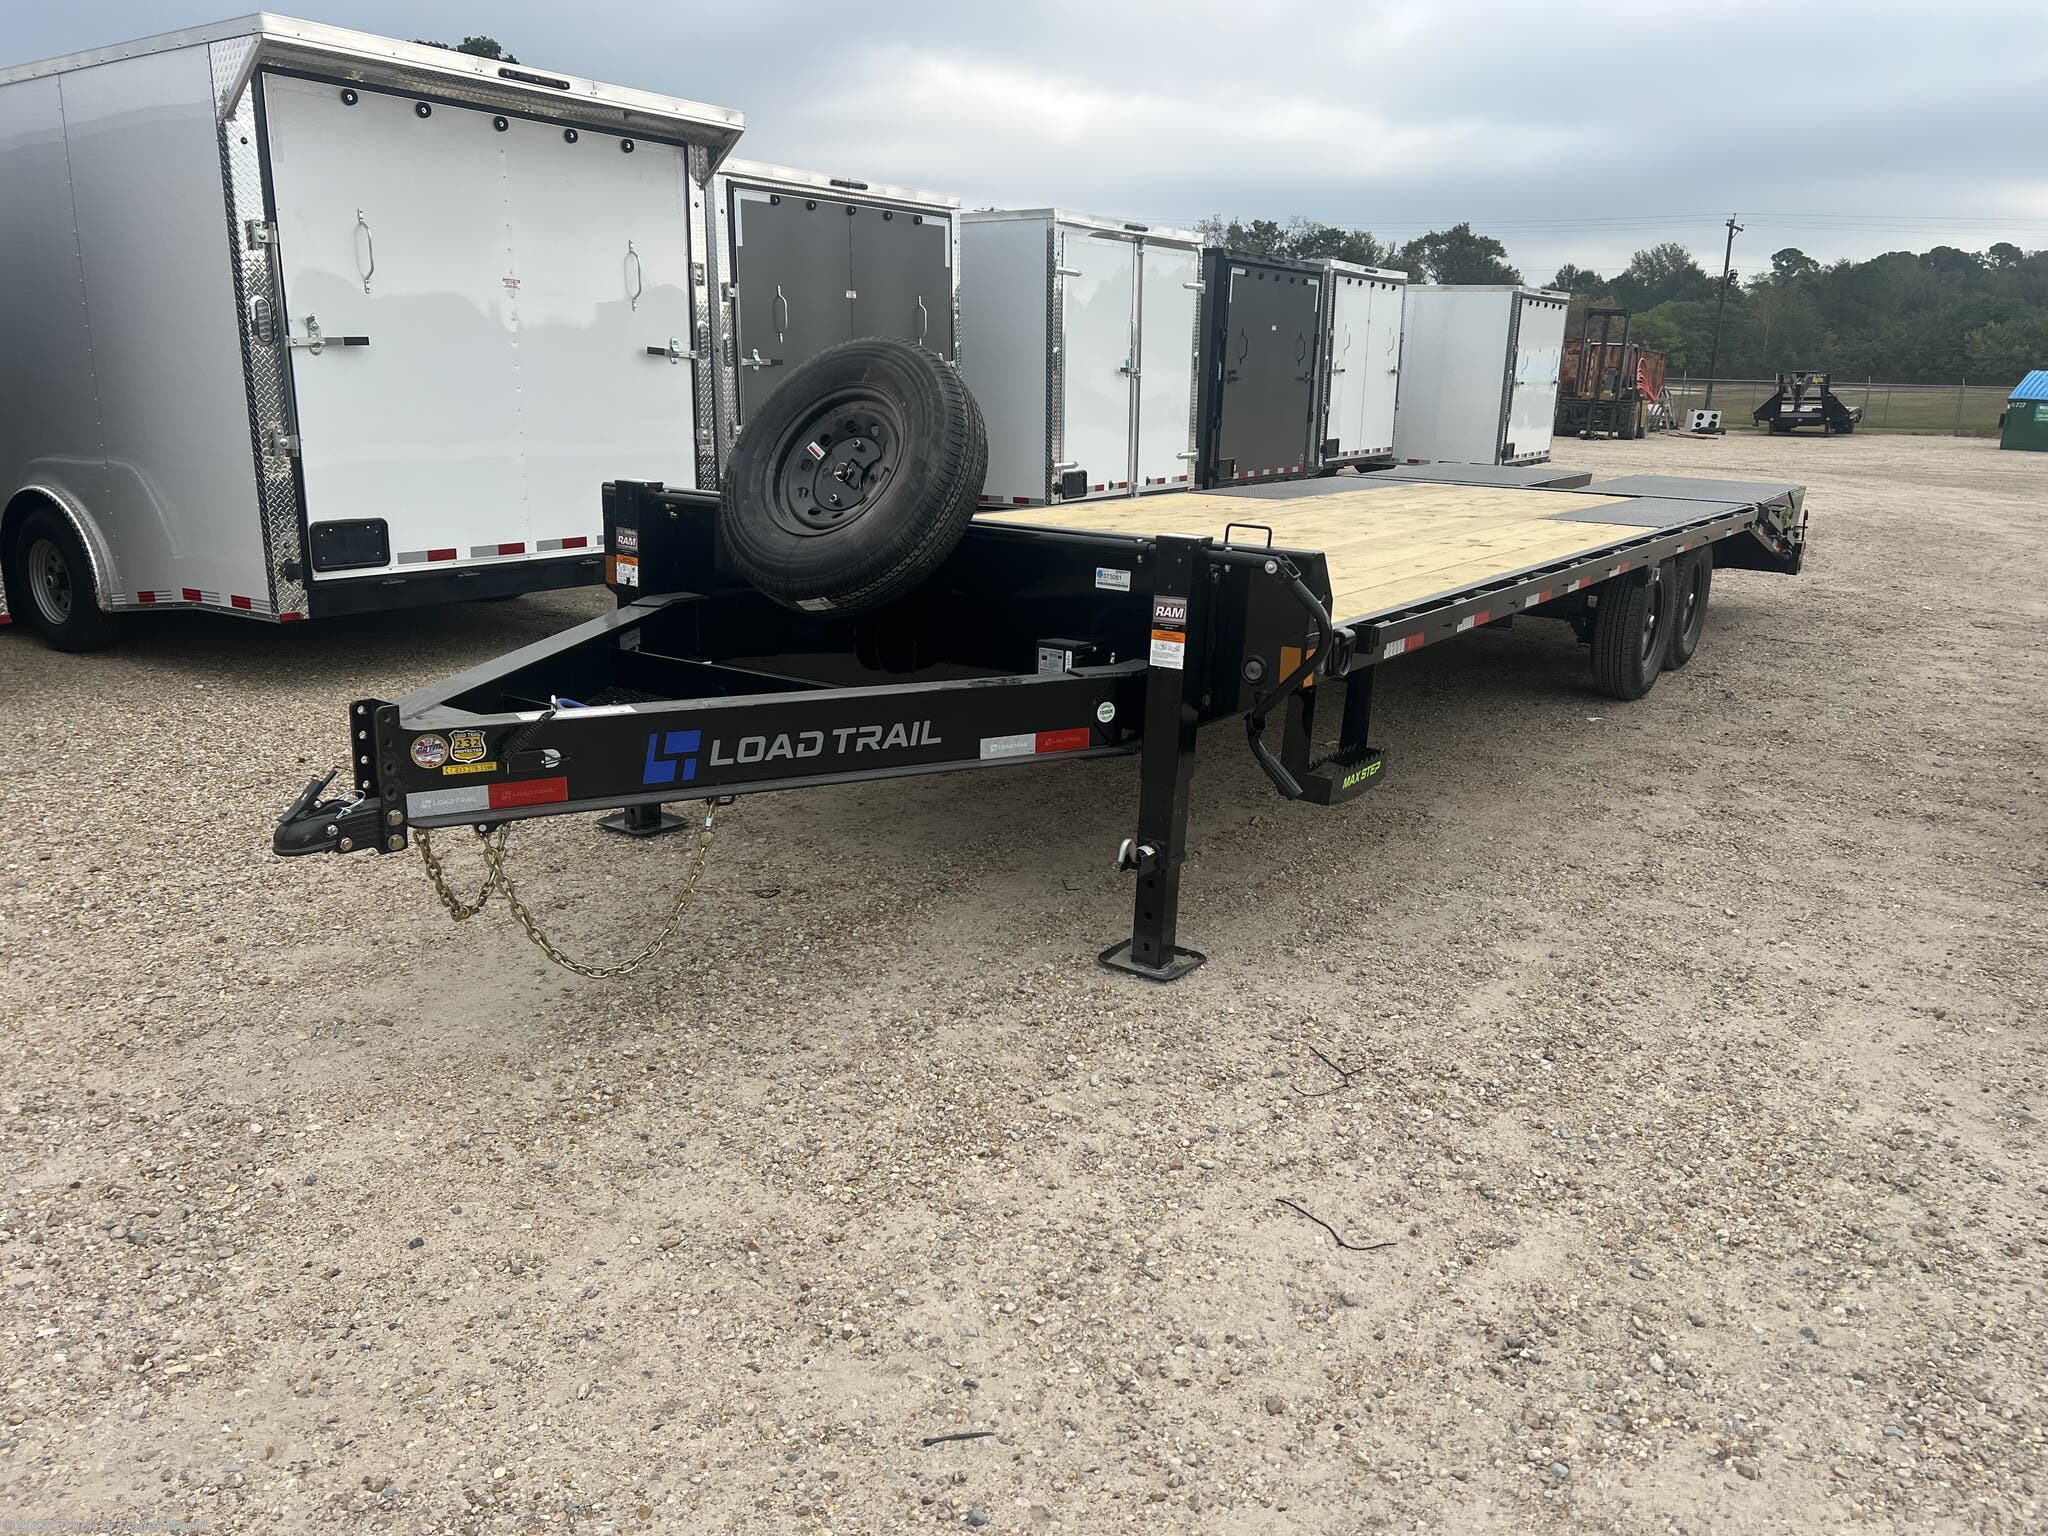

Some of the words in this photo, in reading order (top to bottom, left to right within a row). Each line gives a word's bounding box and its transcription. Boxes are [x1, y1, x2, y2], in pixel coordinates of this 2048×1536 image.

[617, 535, 636, 546] RAM
[1155, 606, 1184, 619] RAM
[456, 738, 480, 748] 232
[709, 731, 825, 767] LOAD
[832, 720, 942, 754] TRAIL
[1342, 770, 1361, 790] MAX
[1360, 760, 1381, 780] STEP
